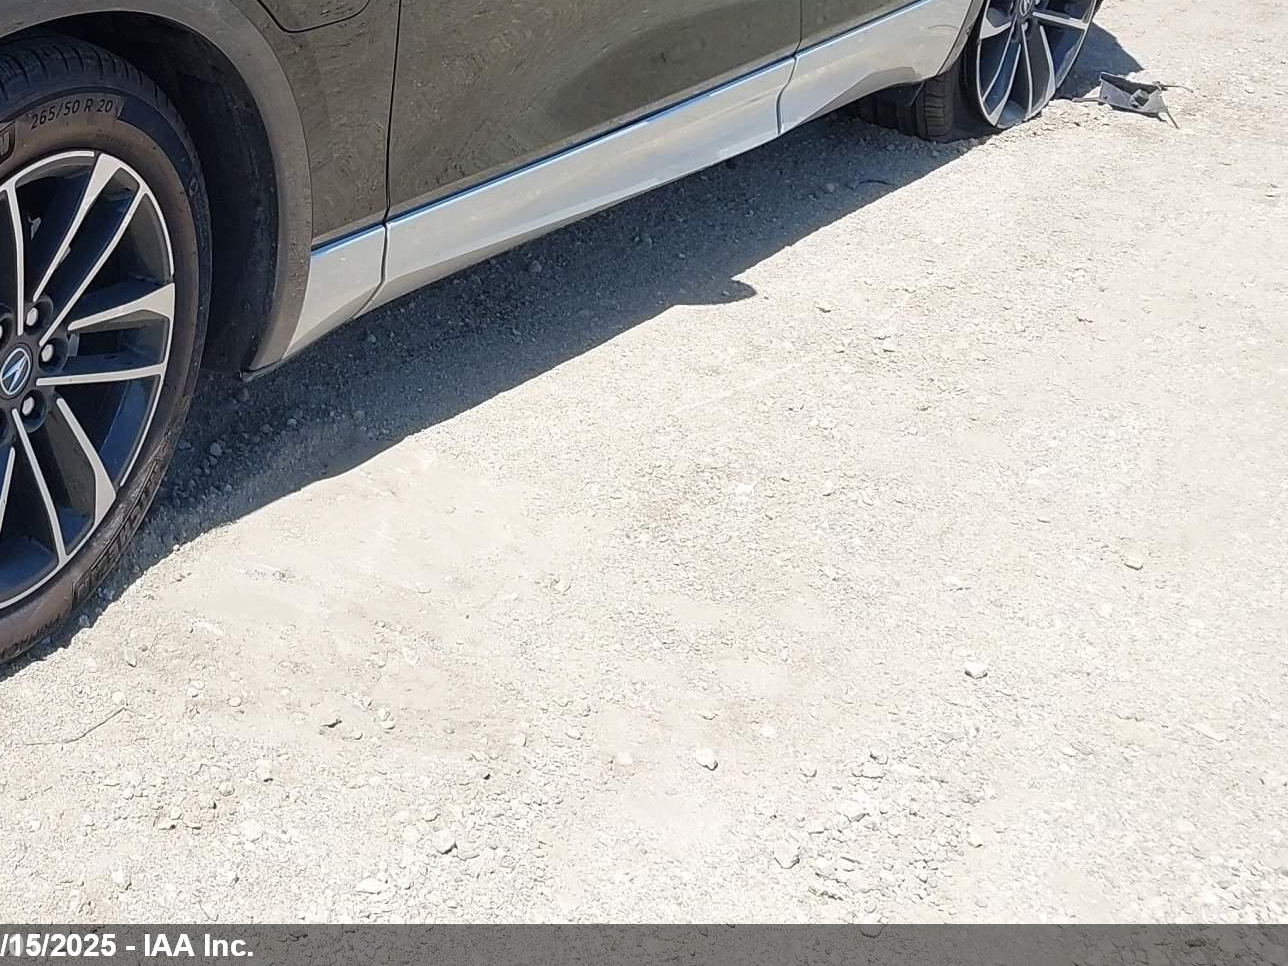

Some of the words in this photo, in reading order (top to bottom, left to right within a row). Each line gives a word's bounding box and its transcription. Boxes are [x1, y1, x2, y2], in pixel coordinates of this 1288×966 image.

[30, 99, 81, 131] 265/50
[83, 98, 94, 113] R
[96, 98, 114, 114] 20
